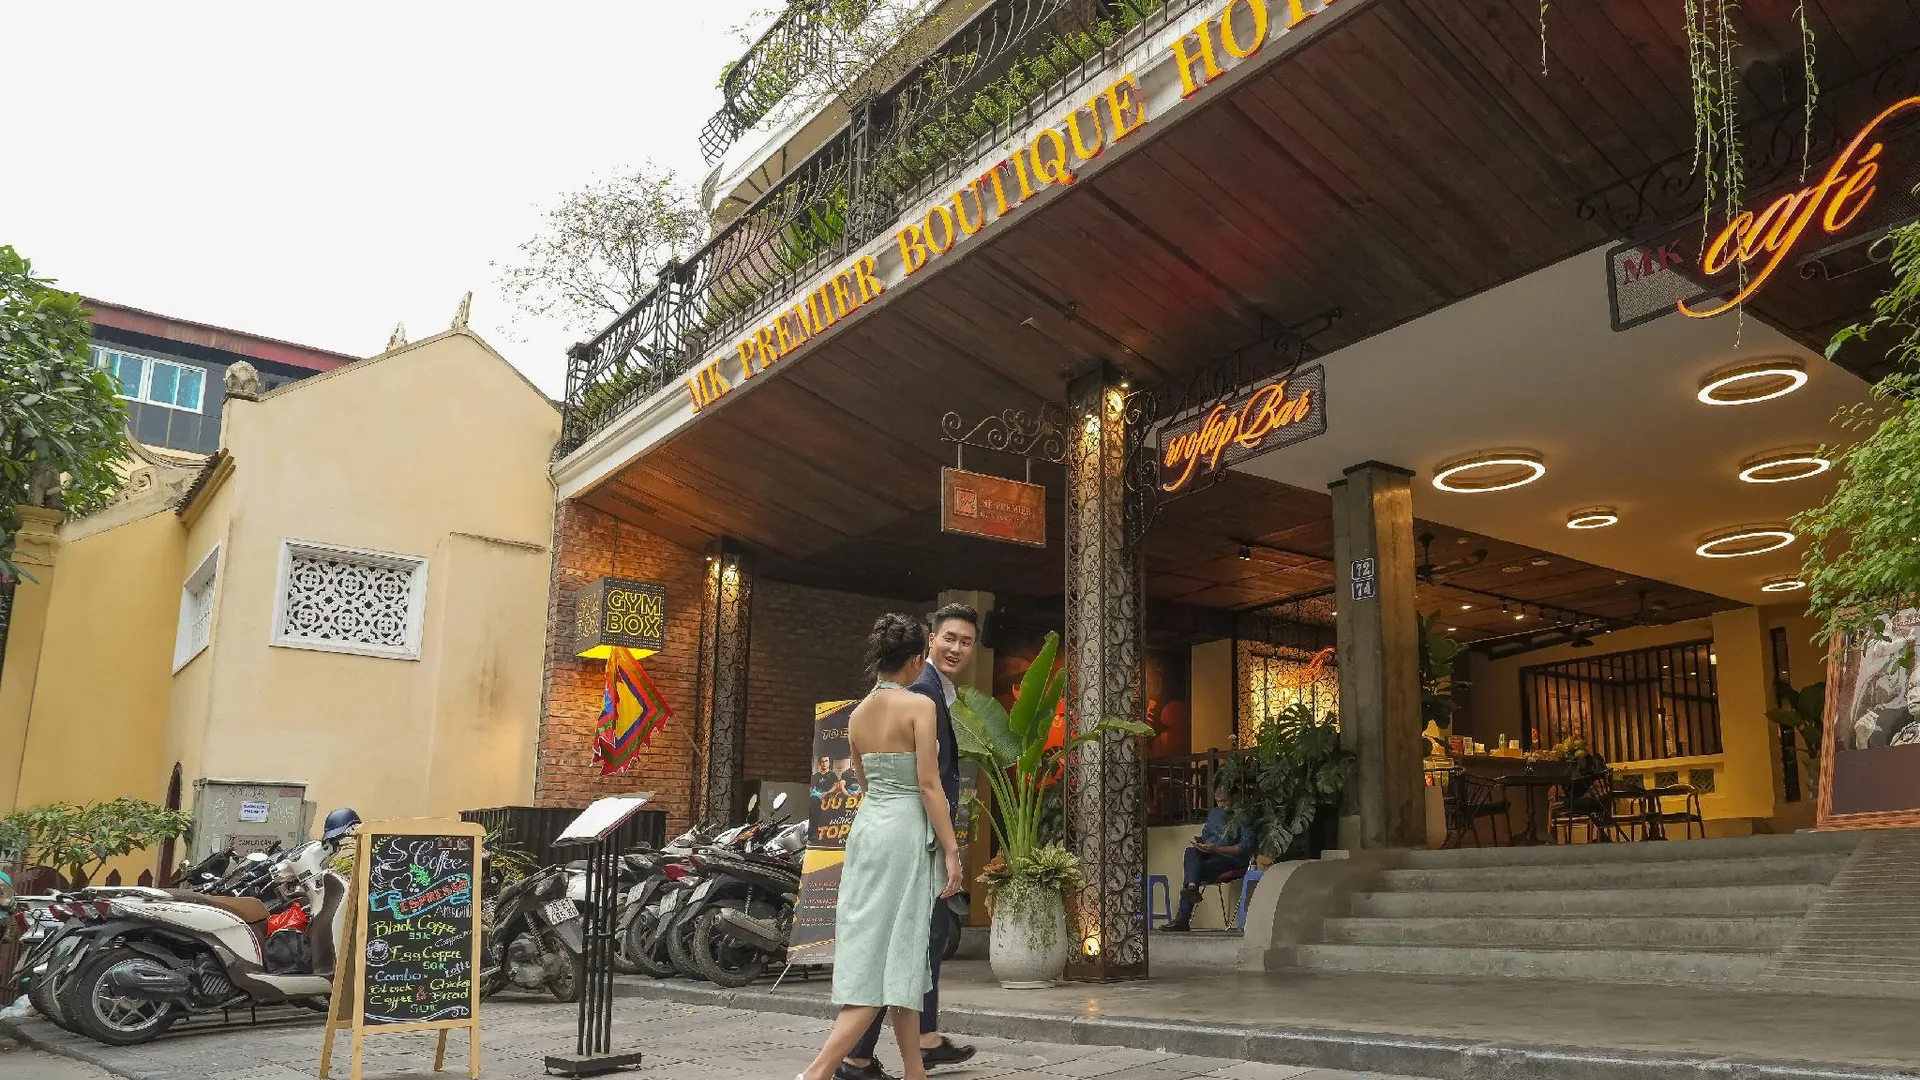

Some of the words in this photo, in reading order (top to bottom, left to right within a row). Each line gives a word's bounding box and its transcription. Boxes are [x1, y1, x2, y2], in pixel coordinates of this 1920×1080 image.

[685, 358, 735, 414] MK
[736, 255, 885, 380] PREMIER
[895, 73, 1150, 277] BOUTIQUE
[1622, 240, 1684, 285] MK
[1355, 562, 1371, 577] 72
[1356, 581, 1371, 597] 74
[607, 590, 661, 615] GYM
[606, 611, 660, 638] BOX
[409, 840, 469, 879] Coffee
[370, 919, 414, 938] Black
[375, 968, 421, 981] Combo
